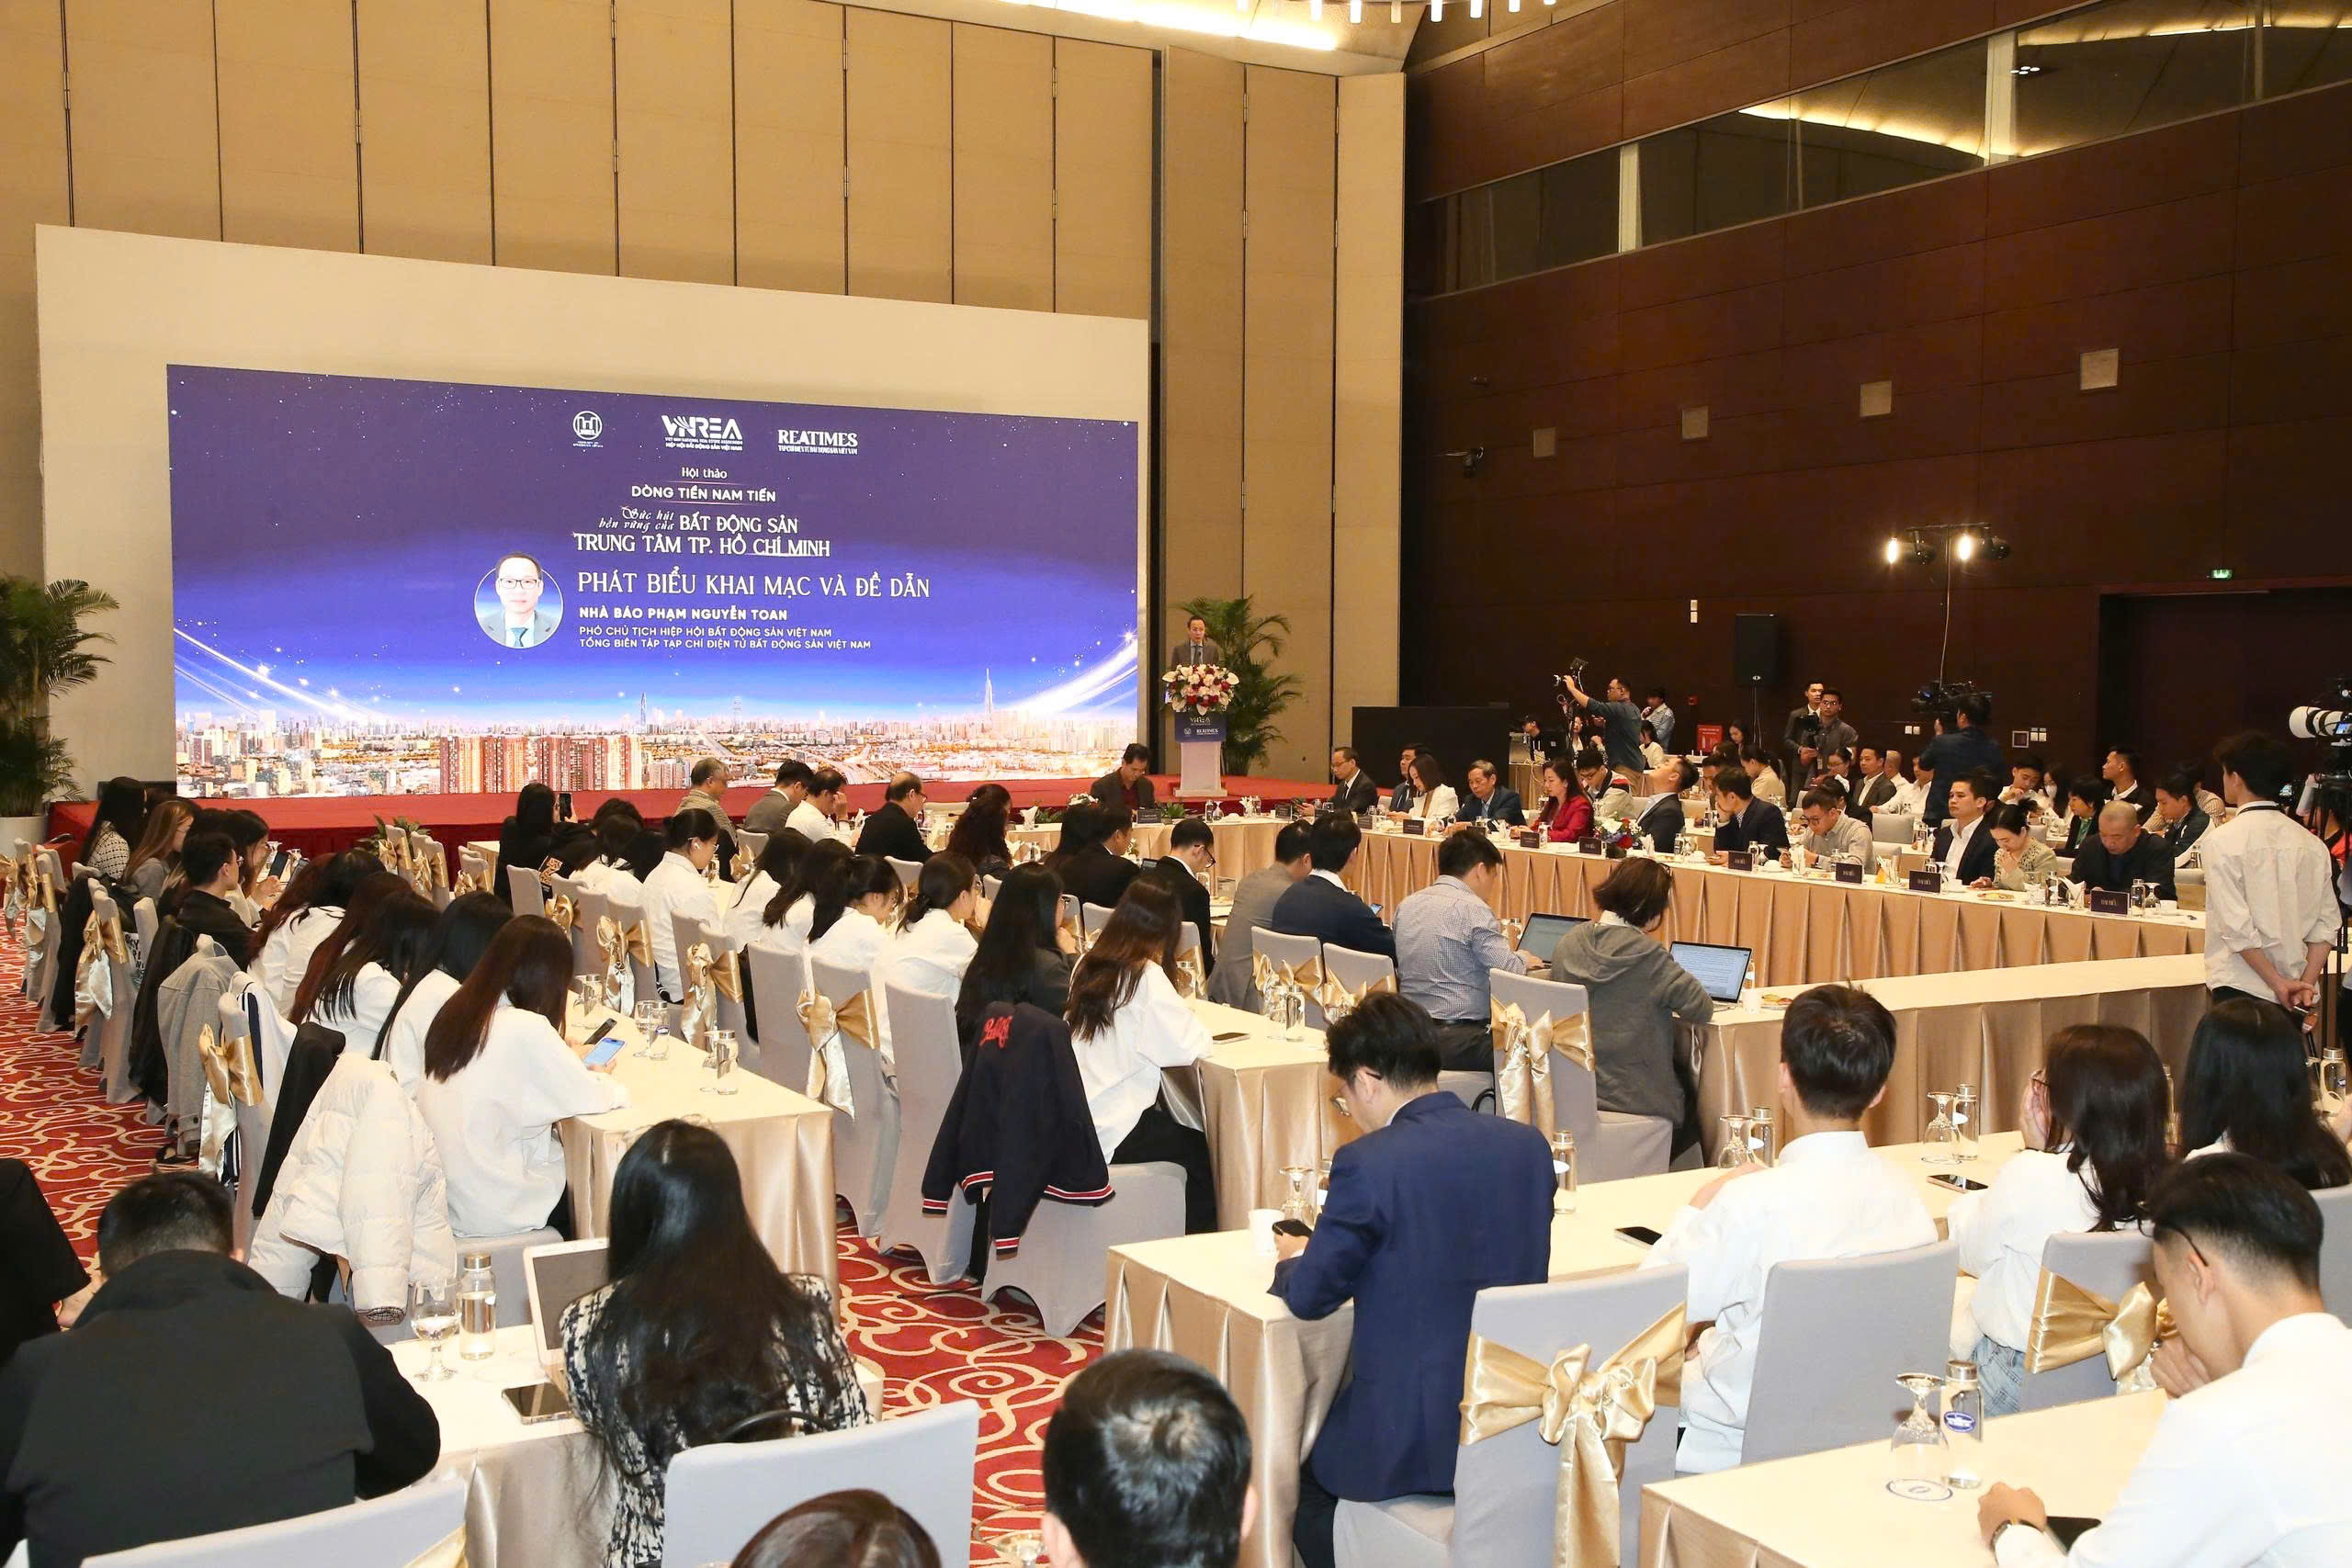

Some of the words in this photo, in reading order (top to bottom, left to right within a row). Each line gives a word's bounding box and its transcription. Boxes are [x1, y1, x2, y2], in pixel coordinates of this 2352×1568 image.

[662, 415, 742, 440] VNREA
[778, 429, 858, 447] REATIMES
[682, 467, 699, 479] Hội
[703, 468, 728, 479] thảo
[631, 484, 673, 499] DÒNG
[712, 489, 743, 502] NAM
[747, 488, 776, 502] TIẾN
[679, 512, 711, 532] BẤT
[717, 514, 762, 534] ĐỘNG
[767, 514, 798, 534] SẢN
[573, 533, 636, 553] TRUNG
[642, 534, 682, 554] TÂM
[688, 536, 713, 554] TP.
[719, 533, 747, 555] HỒ
[752, 536, 781, 557] CHÍ
[787, 538, 831, 558] MINH
[578, 569, 638, 592] PHÁT
[647, 566, 696, 594] BIỂU
[706, 574, 755, 595] KHAI
[763, 575, 811, 599] MẠC
[820, 574, 847, 597] VÀ
[855, 570, 882, 597] ĐỀ
[890, 572, 930, 598] DẪN
[579, 605, 609, 618] NHÀ
[613, 605, 643, 619] BÁO
[648, 608, 686, 622] PHẠM
[691, 604, 746, 620] NGUYỄN
[751, 609, 787, 621] TOAN
[579, 625, 603, 636] PHÓ
[605, 625, 628, 636] CHỦ
[632, 626, 657, 637] TỊCH
[660, 626, 683, 637] HIỆP
[686, 626, 705, 637] HỘI
[707, 626, 727, 637] BẤT
[730, 626, 761, 637] ĐỘNG
[763, 626, 784, 637] SẢN
[786, 626, 808, 639] VIỆT
[810, 629, 831, 637] NAM
[580, 637, 611, 648] TỔNG
[614, 637, 638, 648] BIÊN
[640, 637, 660, 649] TẬP
[663, 639, 683, 649] TẠP
[685, 637, 704, 648] CHÍ
[707, 638, 730, 650] ĐIỆN
[750, 638, 768, 649] BẤT
[771, 638, 802, 650] ĐỘNG
[805, 638, 824, 649] SẢN
[827, 639, 847, 650] VIỆT
